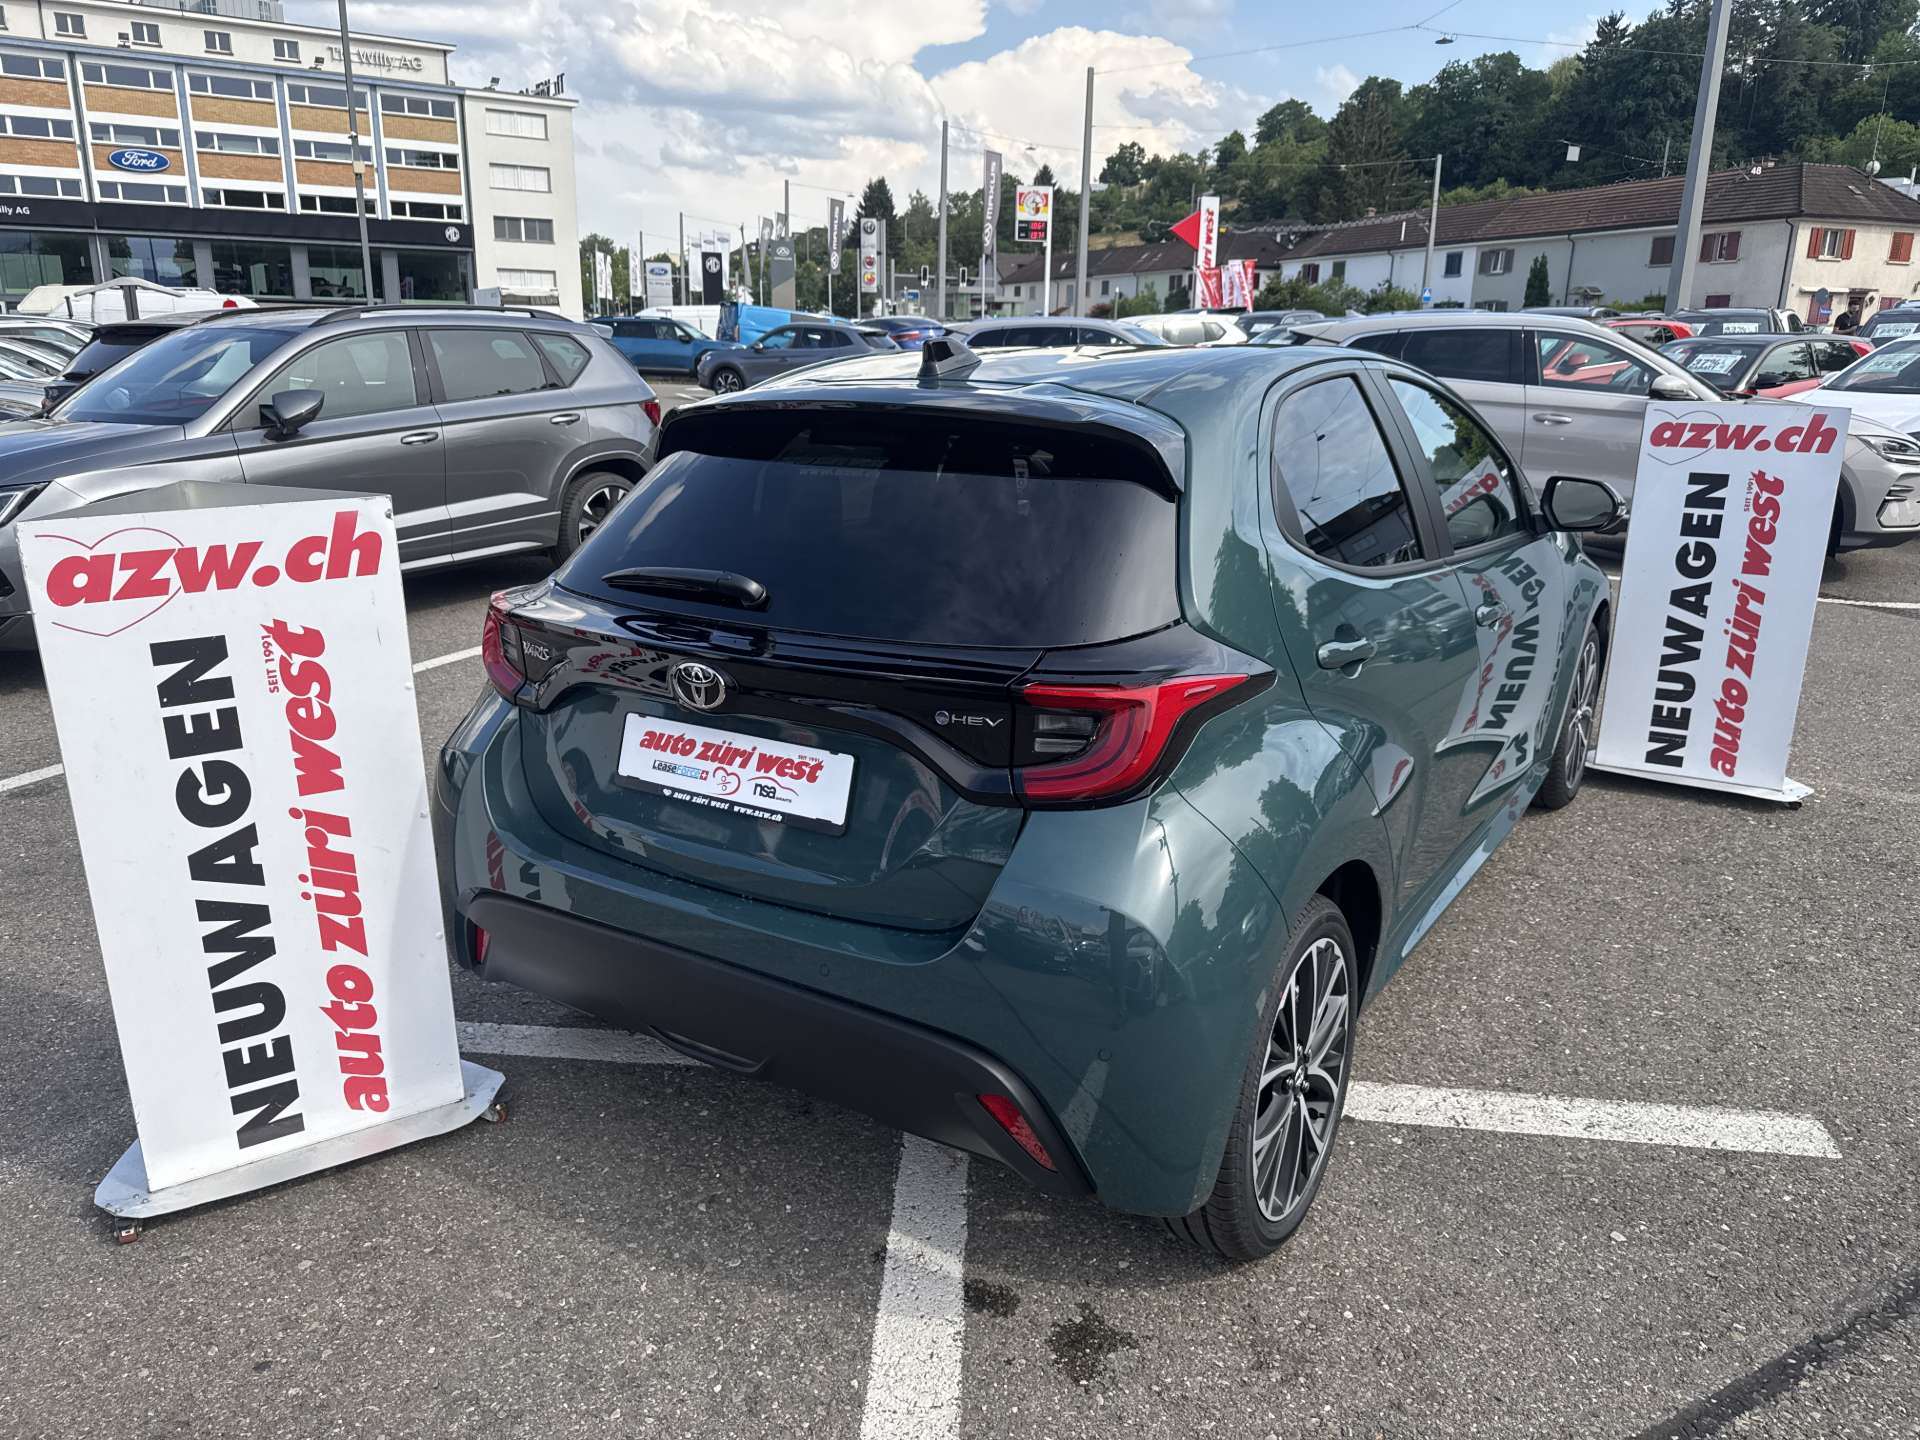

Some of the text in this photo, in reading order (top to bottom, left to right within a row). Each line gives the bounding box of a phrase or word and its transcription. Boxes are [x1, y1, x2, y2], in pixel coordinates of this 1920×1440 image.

[357, 47, 395, 71] Willy
[399, 55, 424, 71] AG
[121, 151, 158, 168] Ford
[16, 207, 30, 215] AG
[1649, 413, 1839, 455] azw.ch
[46, 510, 383, 607] azw.ch
[1644, 472, 1730, 769] NEUWAGEN
[1710, 469, 1785, 778] auto züri west
[260, 634, 280, 694] SEIT 1991
[522, 640, 550, 661] YARIS
[951, 713, 1004, 727] HEV
[639, 729, 825, 784] auto züri west
[672, 792, 783, 822] auto züri west www.azw.ch
[753, 782, 777, 800] nsa
[260, 618, 390, 1114] auto züri west
[150, 633, 305, 1151] NEUWAGEN
